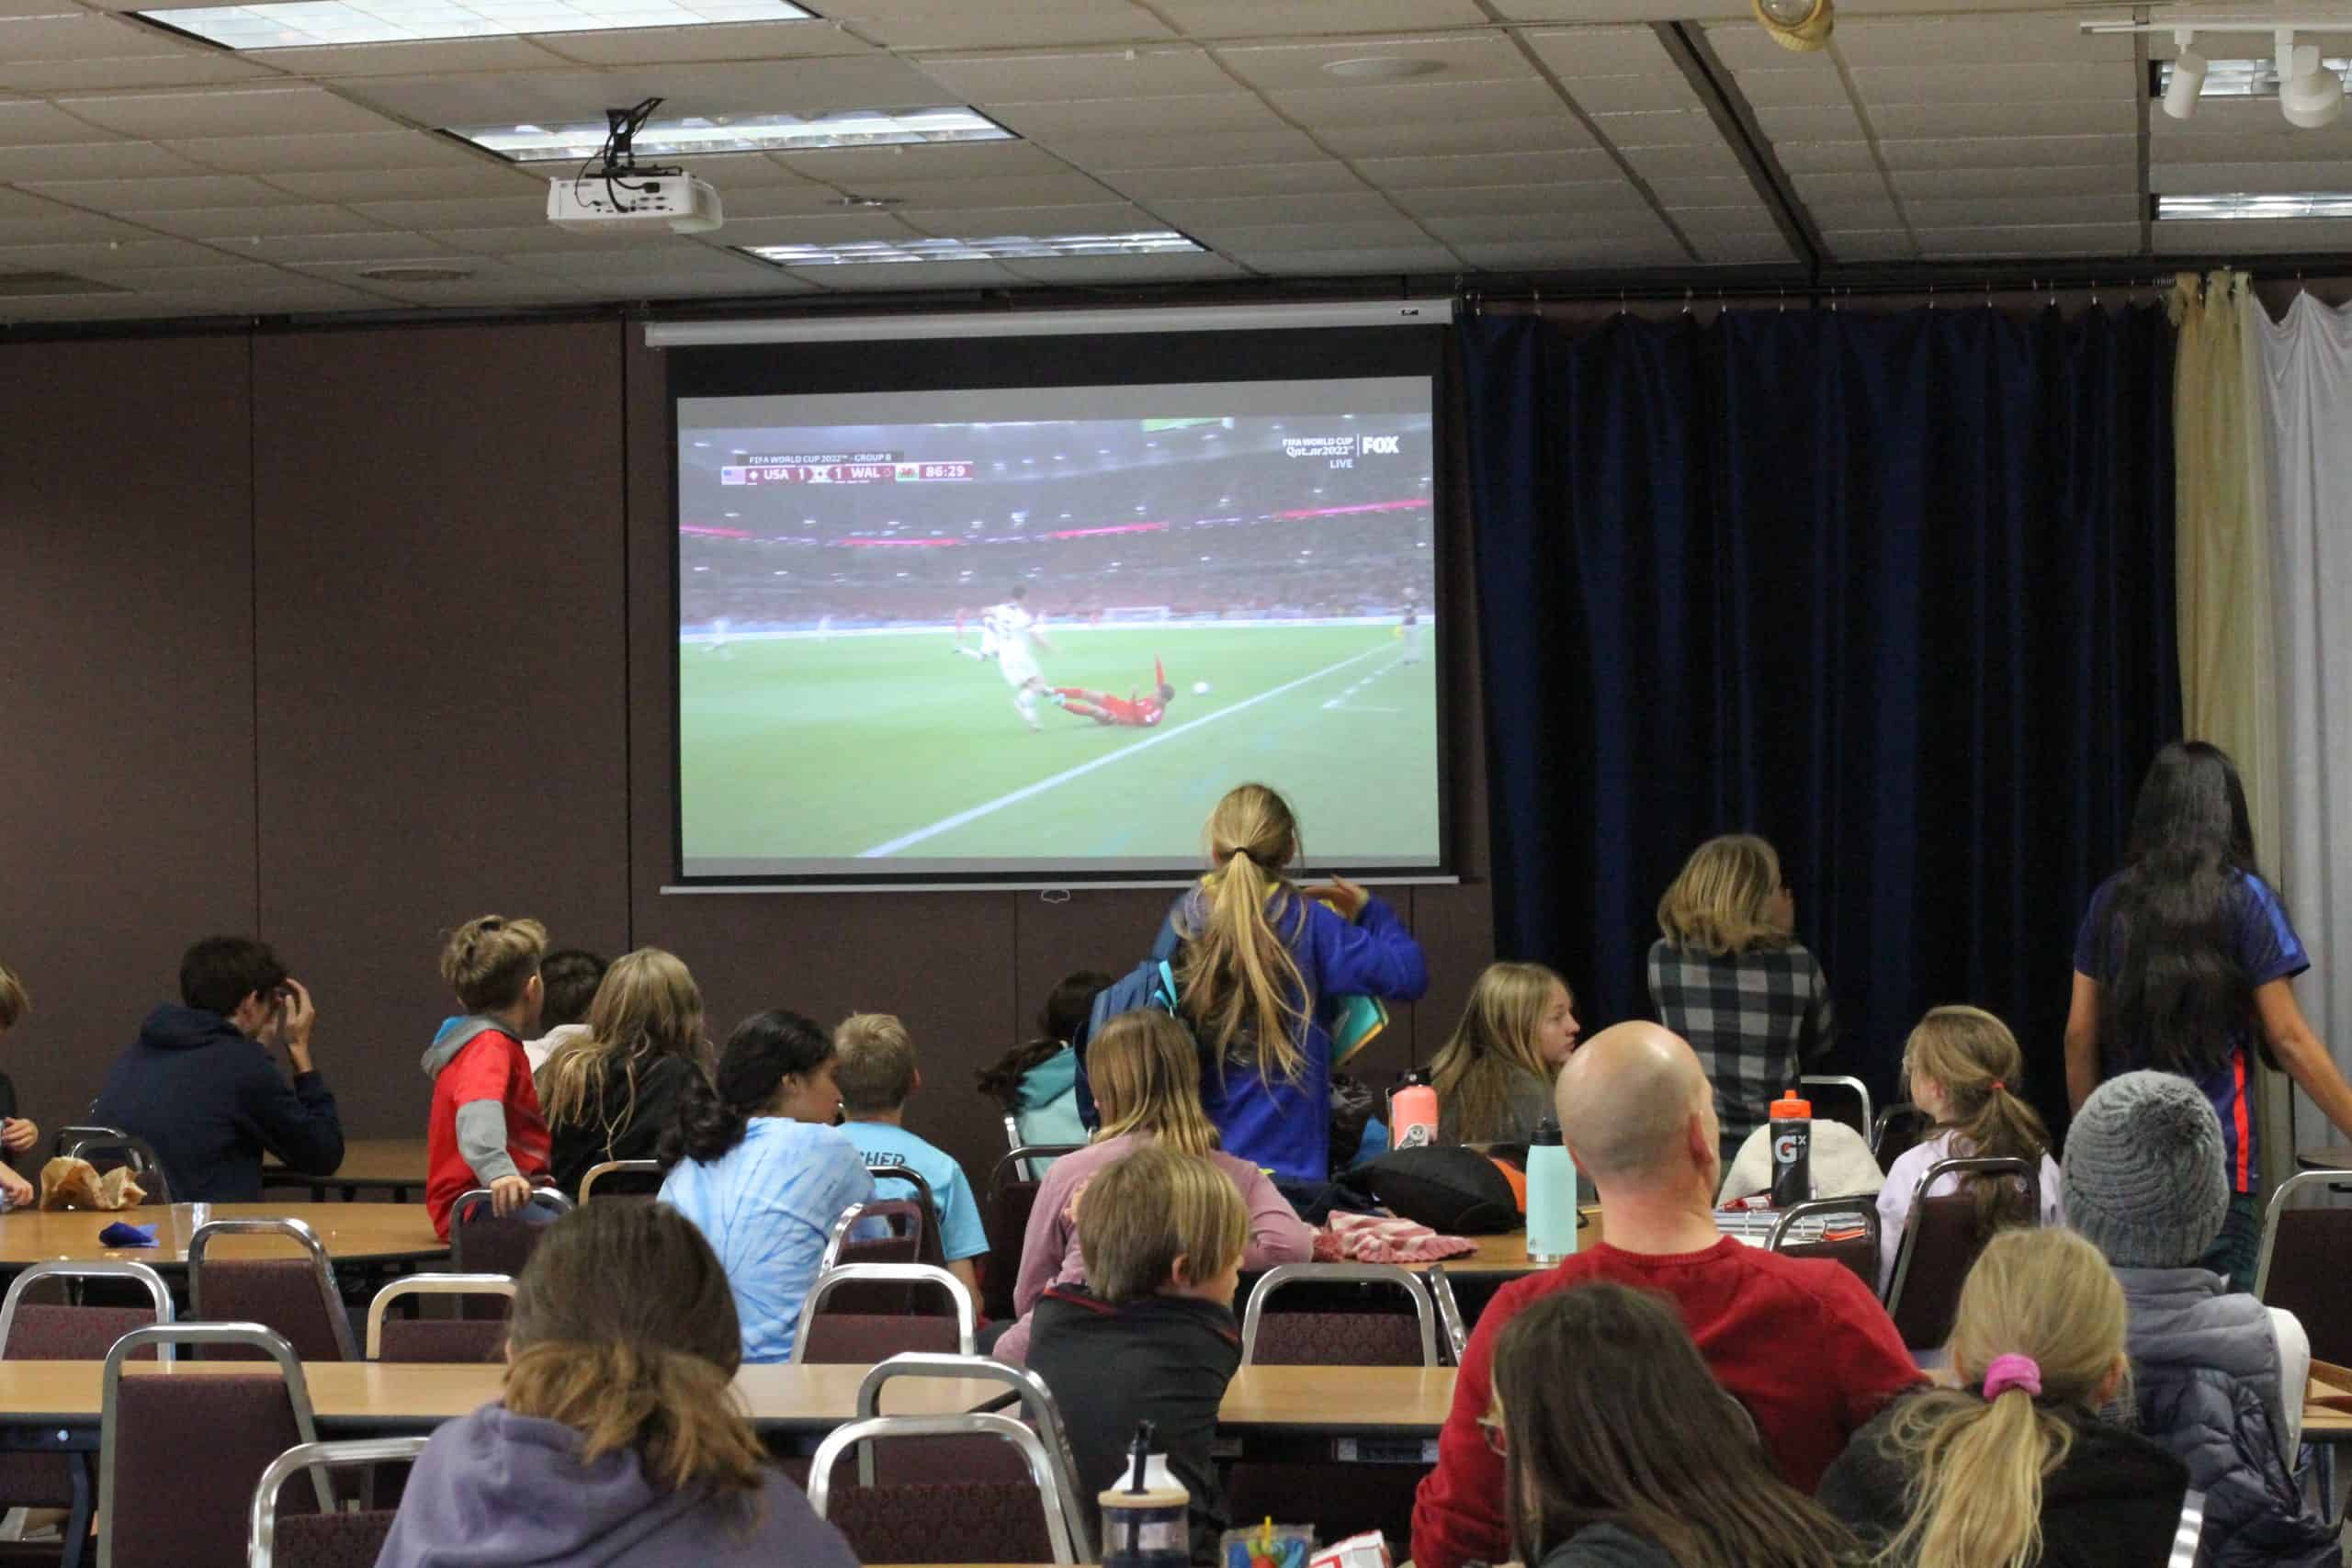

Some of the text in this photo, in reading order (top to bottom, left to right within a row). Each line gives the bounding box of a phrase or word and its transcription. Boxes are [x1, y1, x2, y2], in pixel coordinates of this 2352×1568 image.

[1303, 437, 1334, 446] WORLD
[1336, 436, 1353, 446] CUP
[1362, 436, 1399, 455] FOX
[749, 456, 769, 464] FIFA
[770, 455, 802, 464] WORLD
[802, 455, 820, 464] CUP
[854, 453, 884, 462] GROUP
[1329, 458, 1353, 469] LIVE
[763, 468, 789, 480] USA
[851, 466, 881, 479] WAL
[925, 465, 967, 478] 86:29
